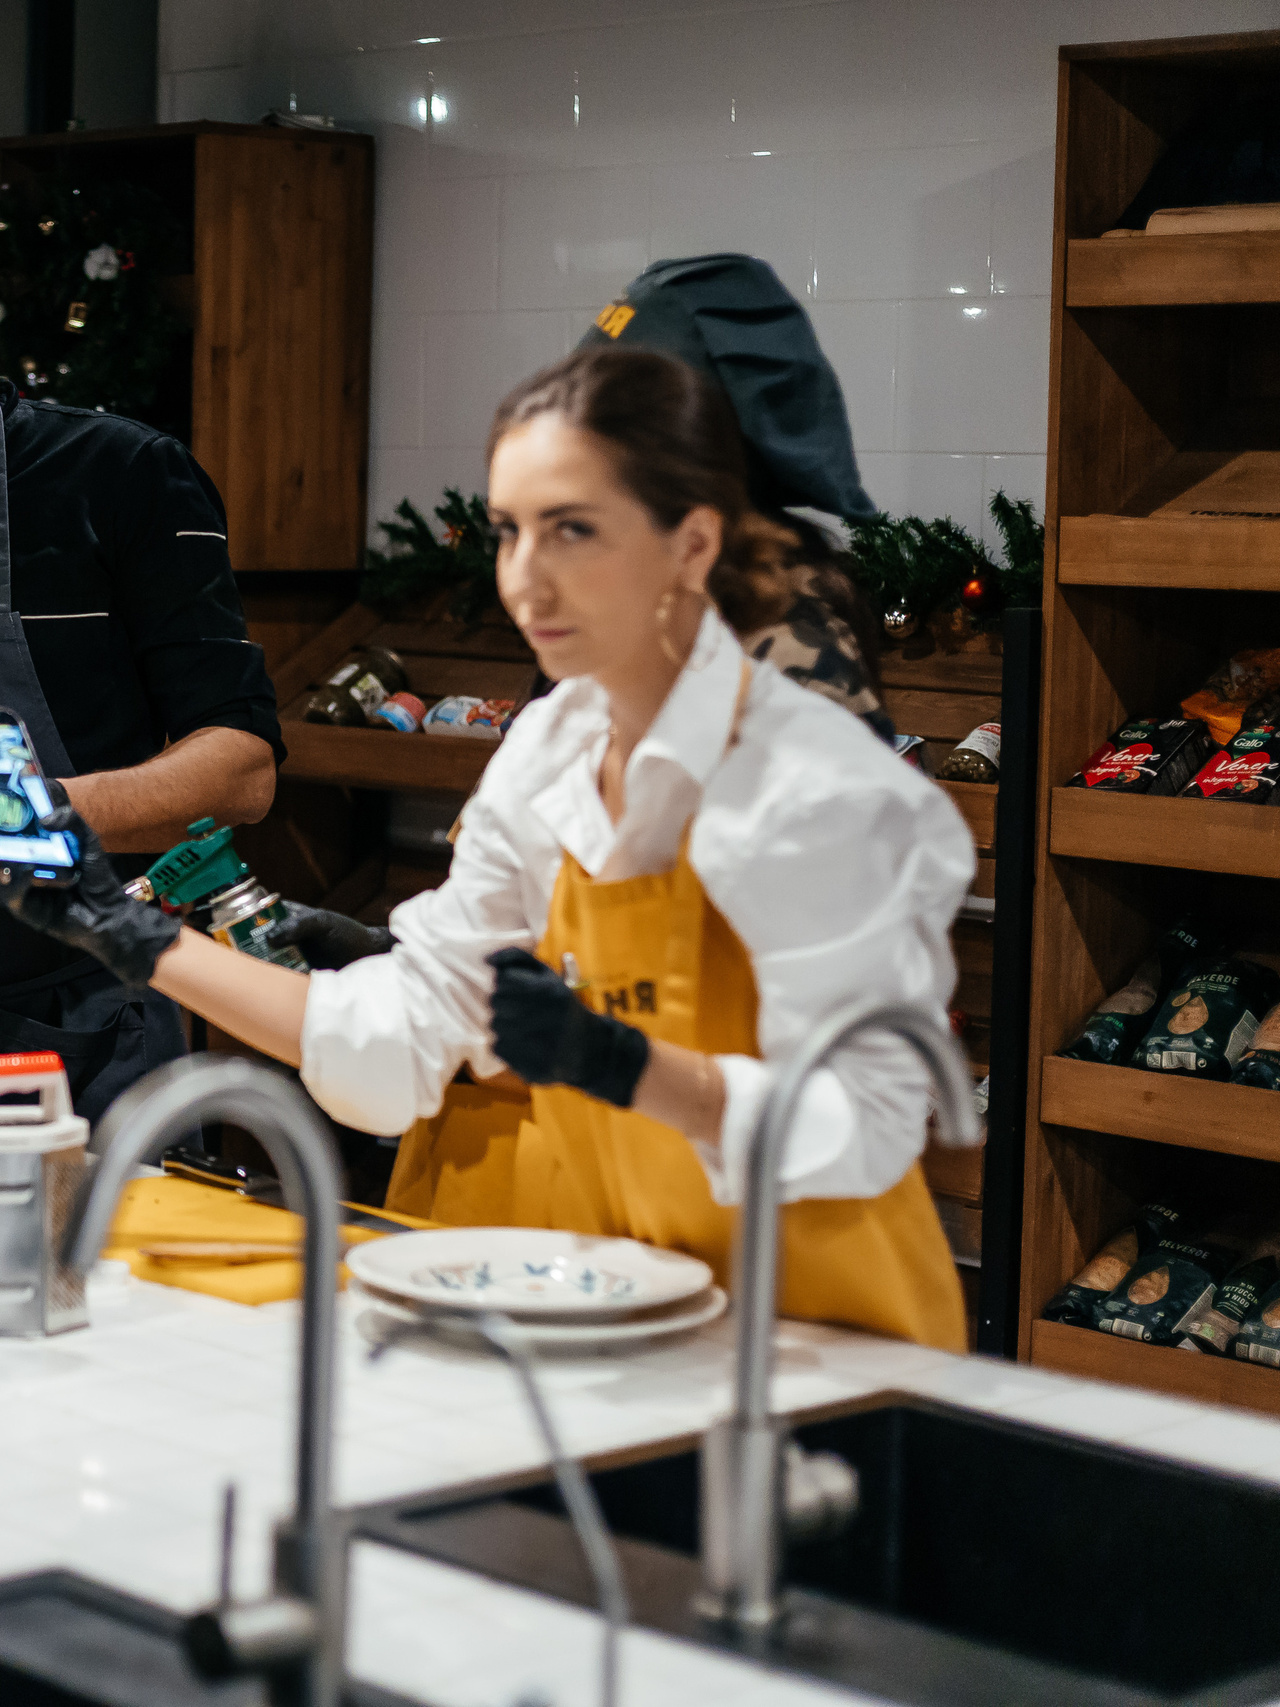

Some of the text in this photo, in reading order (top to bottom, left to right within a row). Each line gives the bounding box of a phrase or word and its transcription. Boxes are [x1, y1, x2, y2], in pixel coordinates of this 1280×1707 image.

[1120, 730, 1148, 740] Gallo
[1234, 738, 1264, 748] Gallo
[1100, 749, 1161, 763] Venere
[1215, 758, 1280, 773] Venere
[1159, 1240, 1210, 1259] DELVERDE
[1231, 1294, 1250, 1308] NIDO
